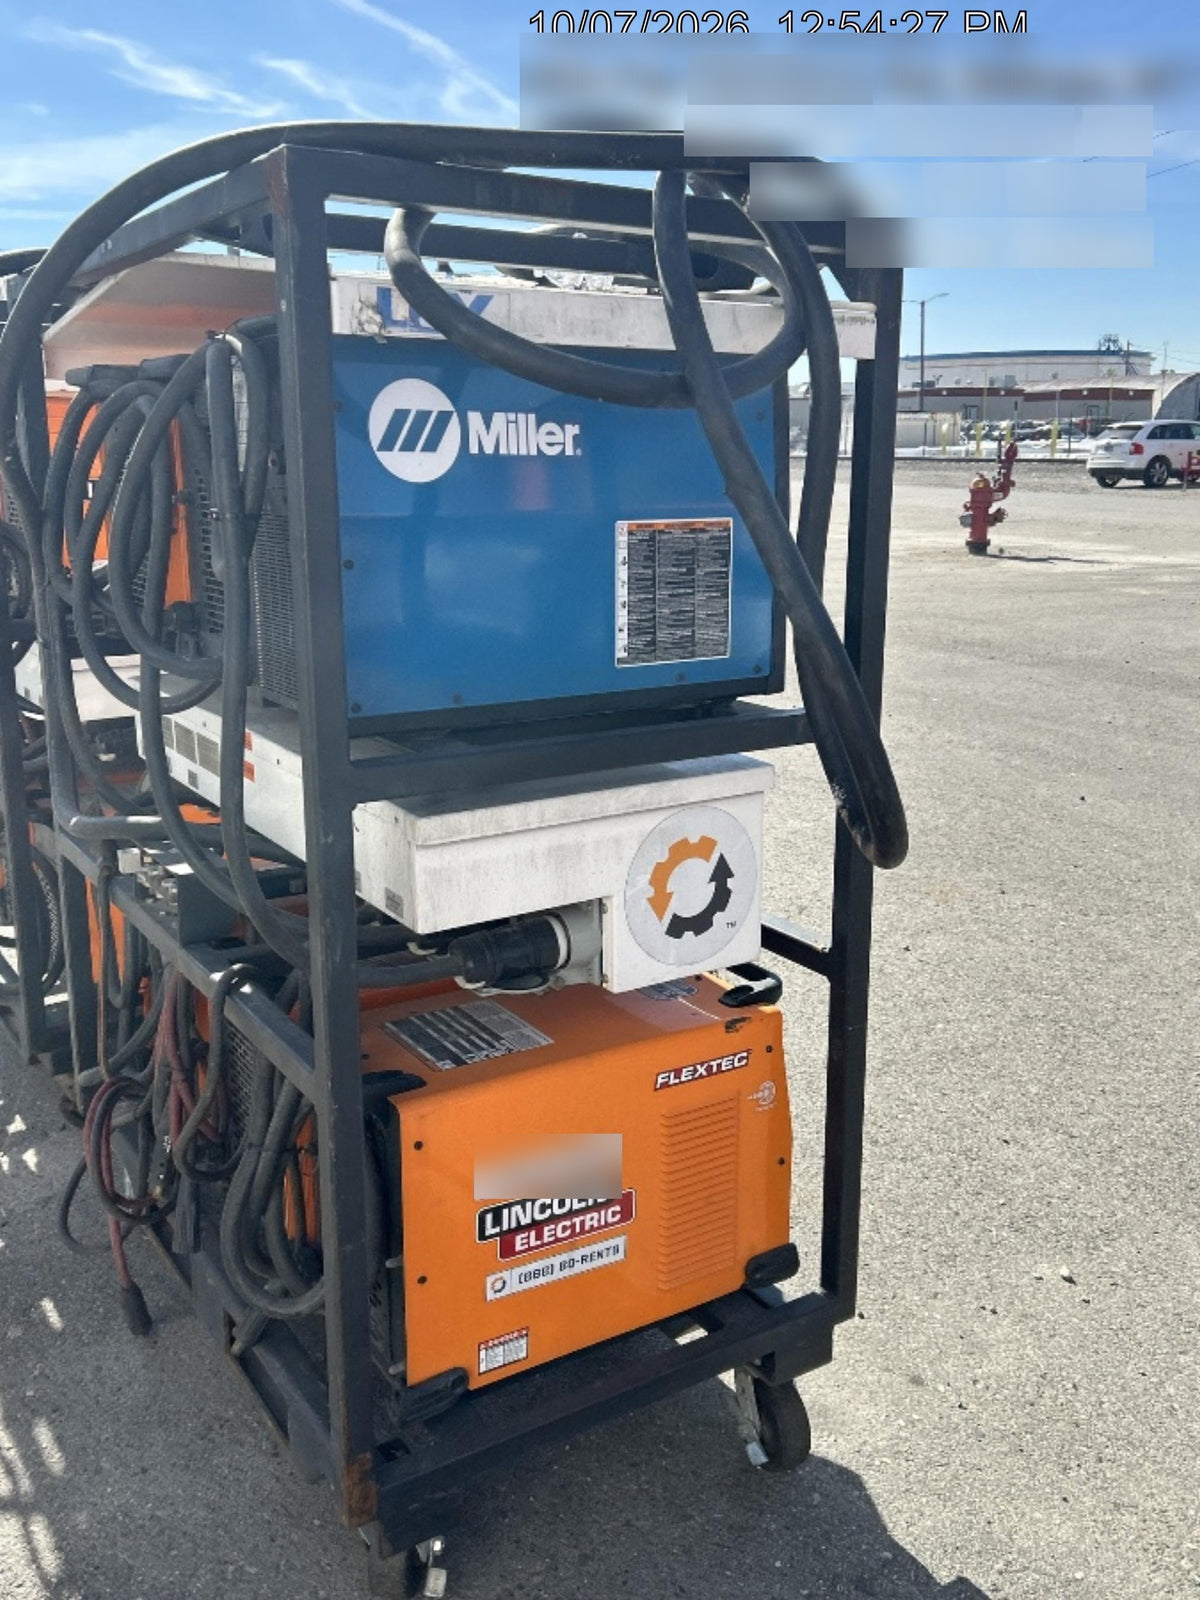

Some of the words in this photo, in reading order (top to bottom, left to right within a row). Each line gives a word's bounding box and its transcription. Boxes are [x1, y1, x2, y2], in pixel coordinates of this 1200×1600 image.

[467, 410, 581, 456] Miller
[655, 1051, 749, 1089] FLEXTEC
[514, 1204, 622, 1252] ELECTRIC
